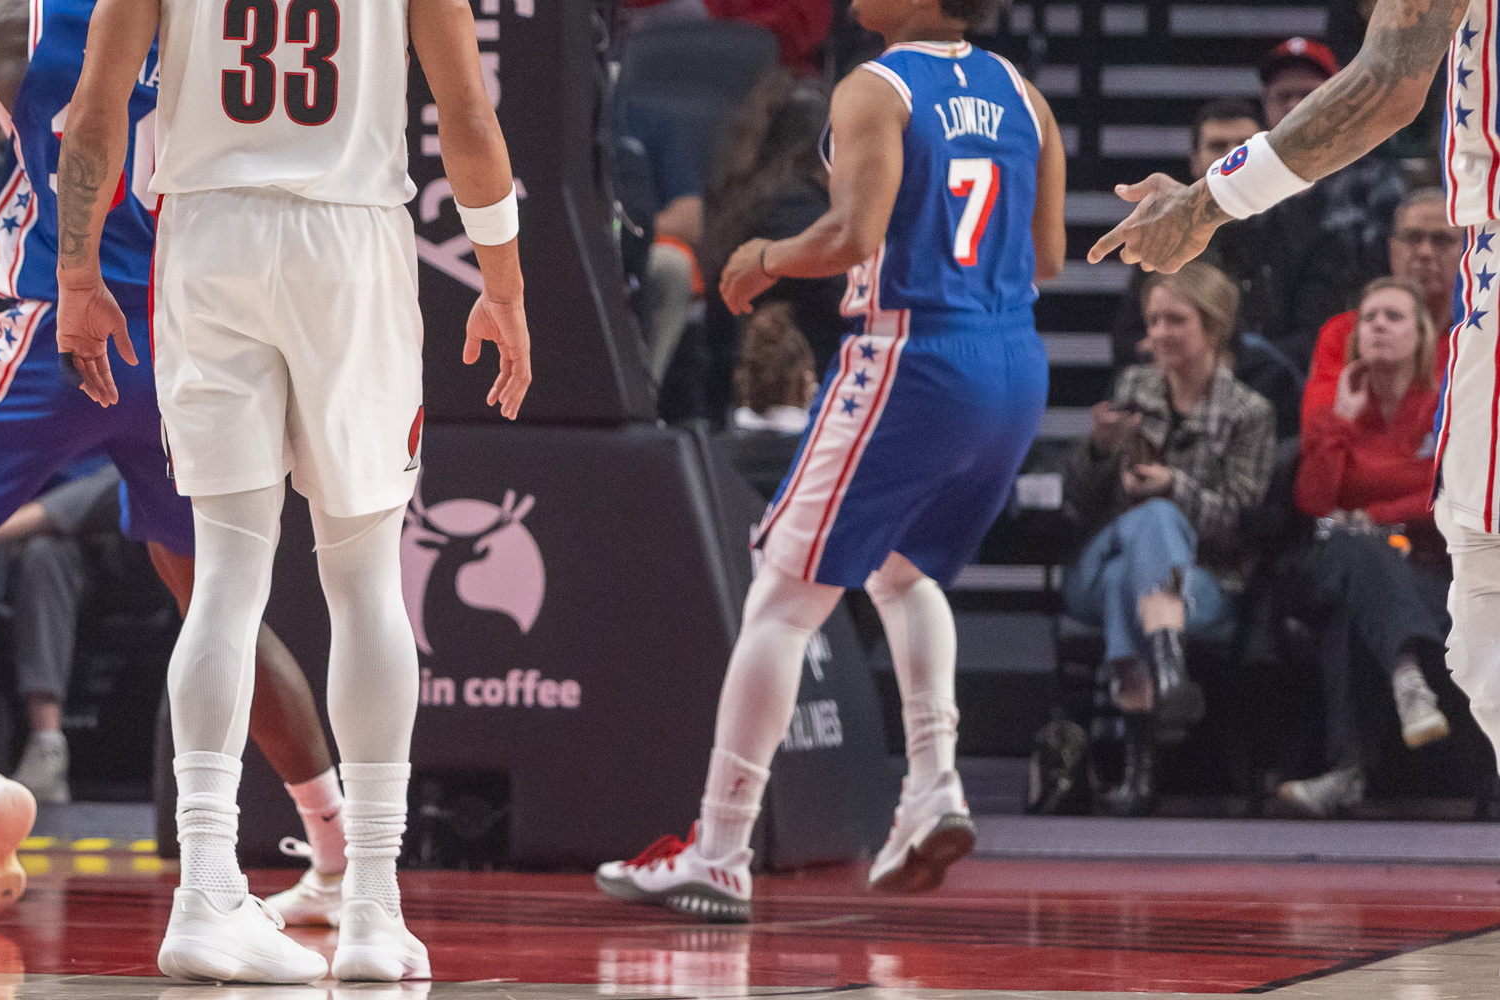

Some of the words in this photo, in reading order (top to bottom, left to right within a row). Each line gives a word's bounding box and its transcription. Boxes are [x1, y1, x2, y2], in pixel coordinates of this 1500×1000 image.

[934, 95, 1005, 141] LOWRY
[1220, 145, 1248, 177] 9
[947, 157, 1000, 267] 7
[462, 667, 583, 710] coffee
